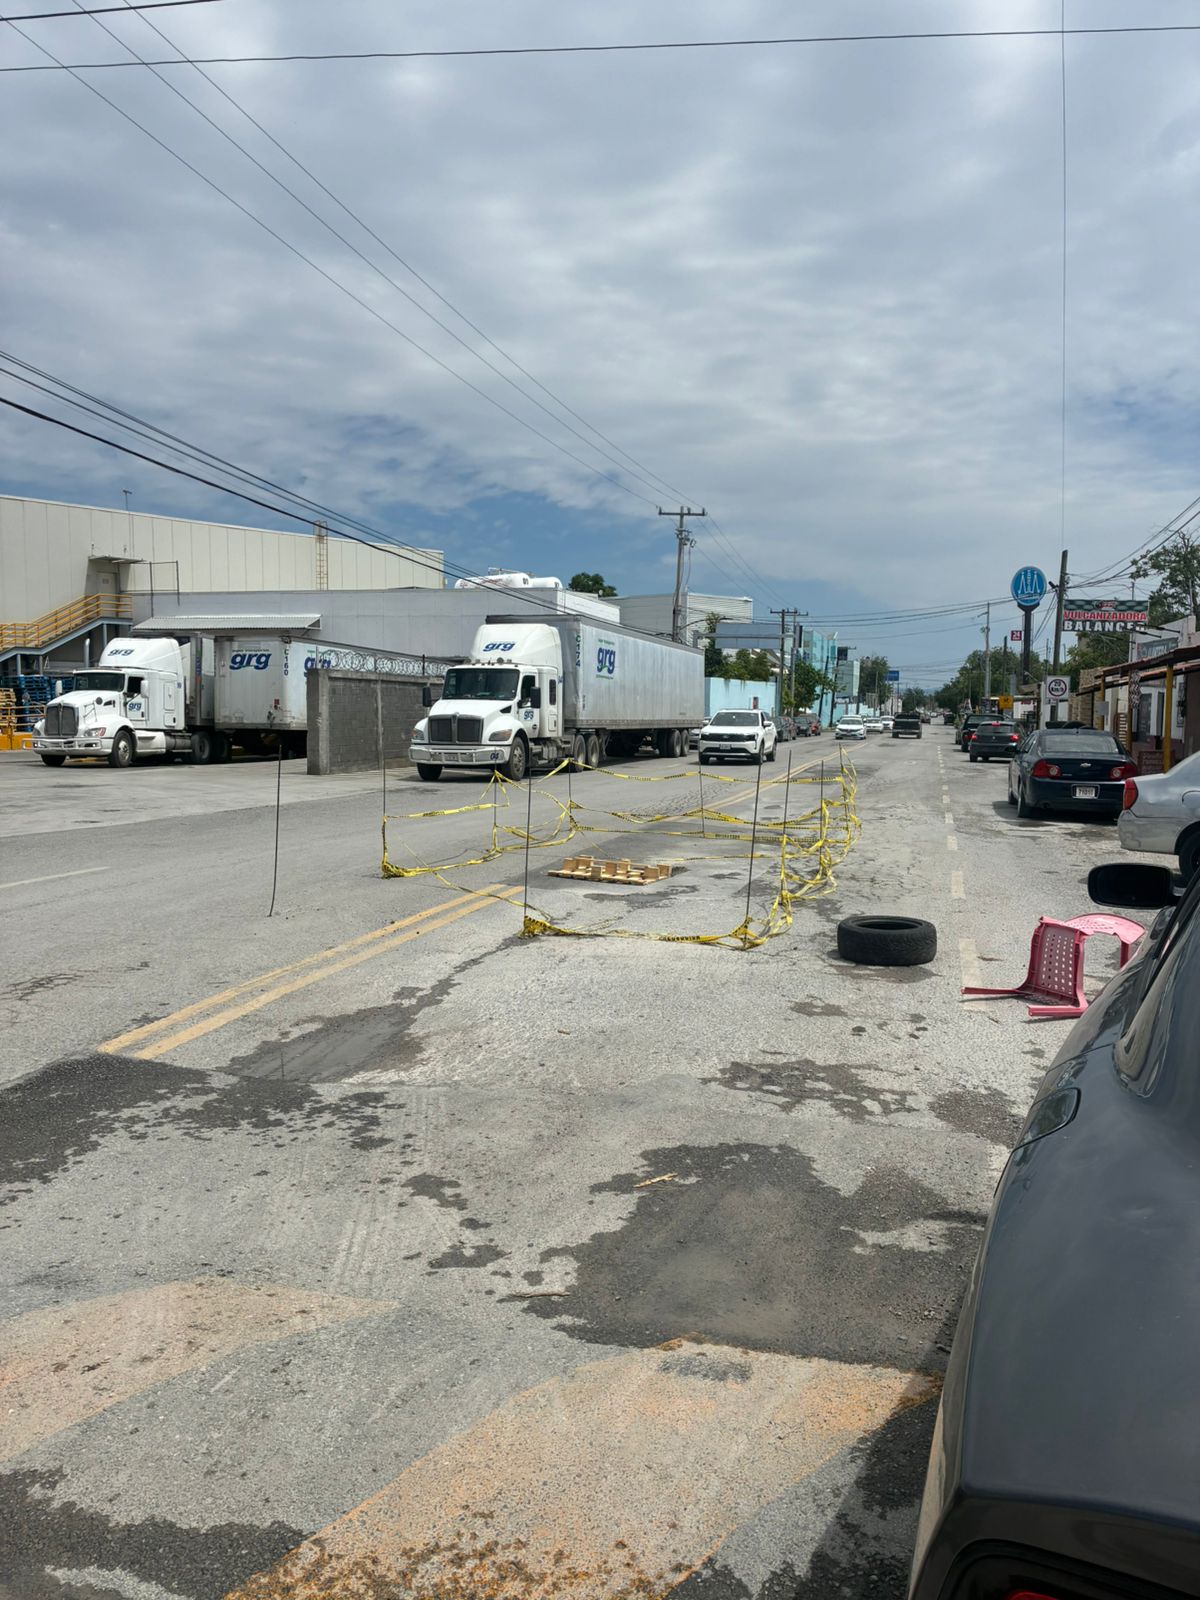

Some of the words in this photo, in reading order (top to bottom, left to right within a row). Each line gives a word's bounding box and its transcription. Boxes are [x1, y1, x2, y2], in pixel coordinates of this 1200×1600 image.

[1064, 611, 1147, 620] VULCANIZADORA
[483, 642, 516, 652] grg
[108, 648, 135, 656] grg
[230, 653, 272, 670] grg
[596, 647, 616, 674] grg
[128, 702, 142, 711] grg
